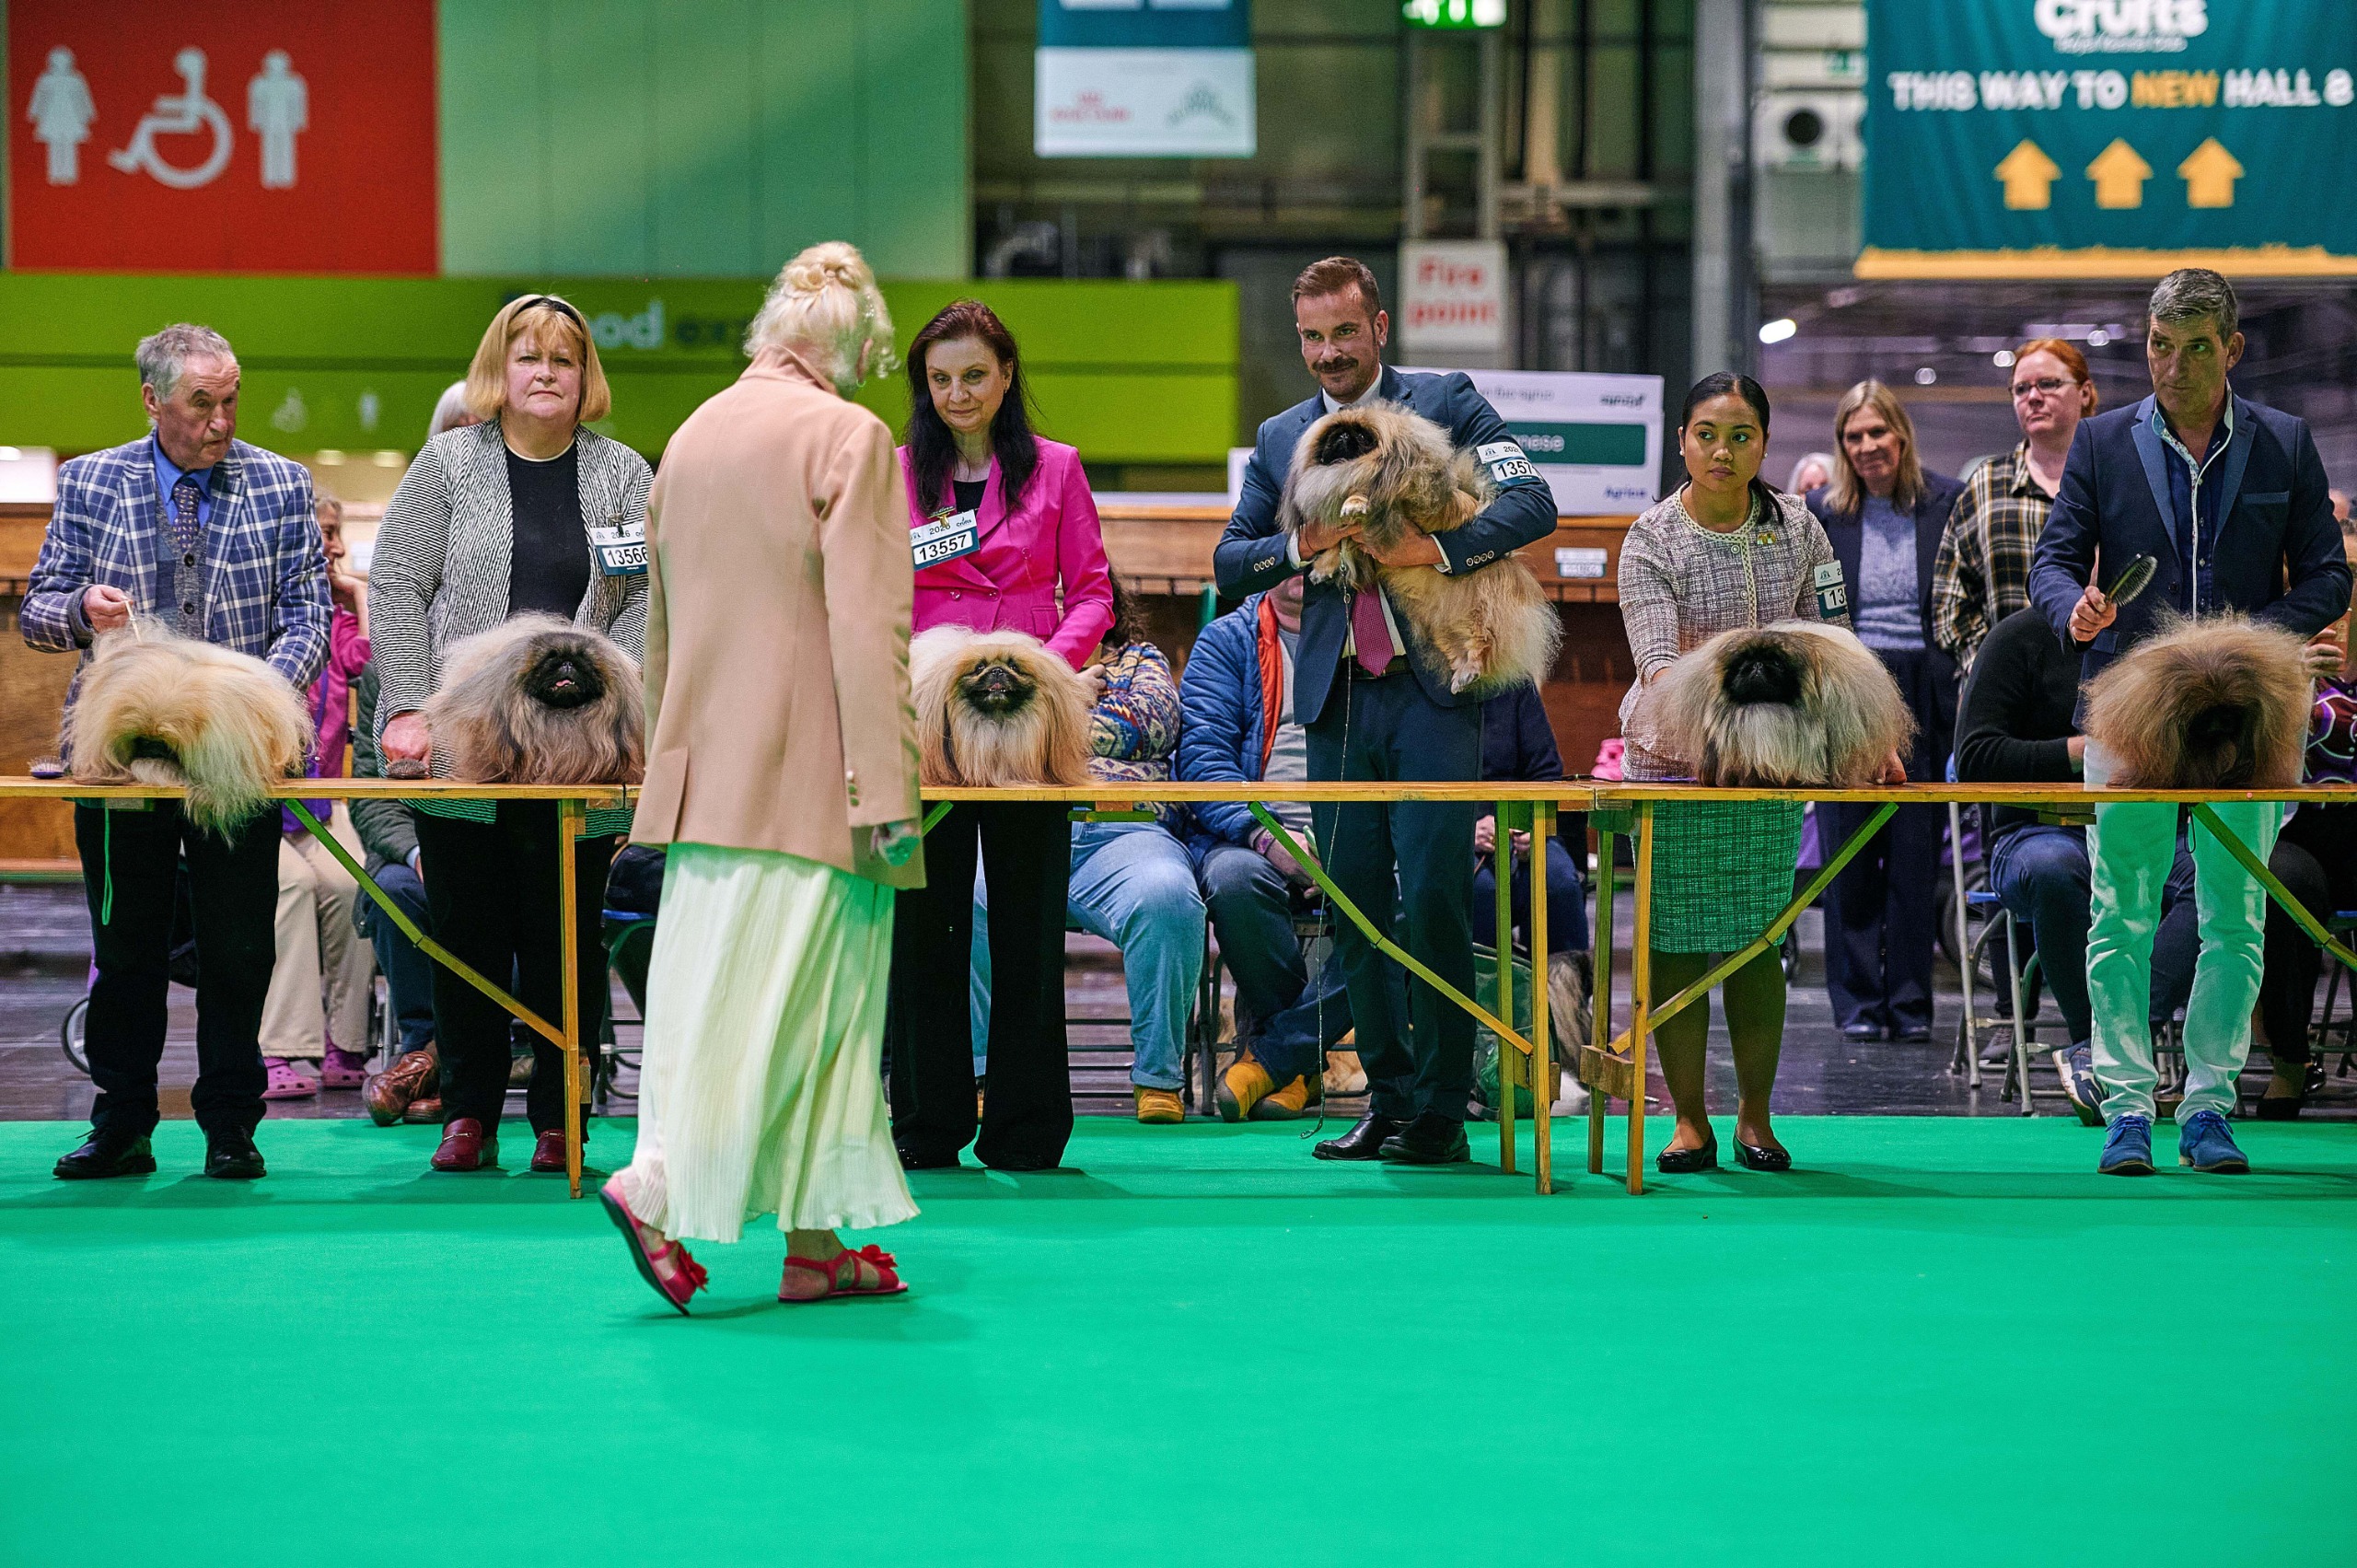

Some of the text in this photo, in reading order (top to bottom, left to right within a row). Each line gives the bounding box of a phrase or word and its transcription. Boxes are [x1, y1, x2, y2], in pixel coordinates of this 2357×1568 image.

[1887, 70, 1978, 111] THIS
[1980, 69, 2070, 110] WAY
[2072, 69, 2128, 110] TO
[2131, 69, 2221, 109] NEW
[2223, 67, 2321, 108] HALL
[1417, 256, 1487, 288] Fire
[1406, 299, 1499, 328] point
[610, 529, 631, 540] 206
[919, 534, 967, 561] 13557
